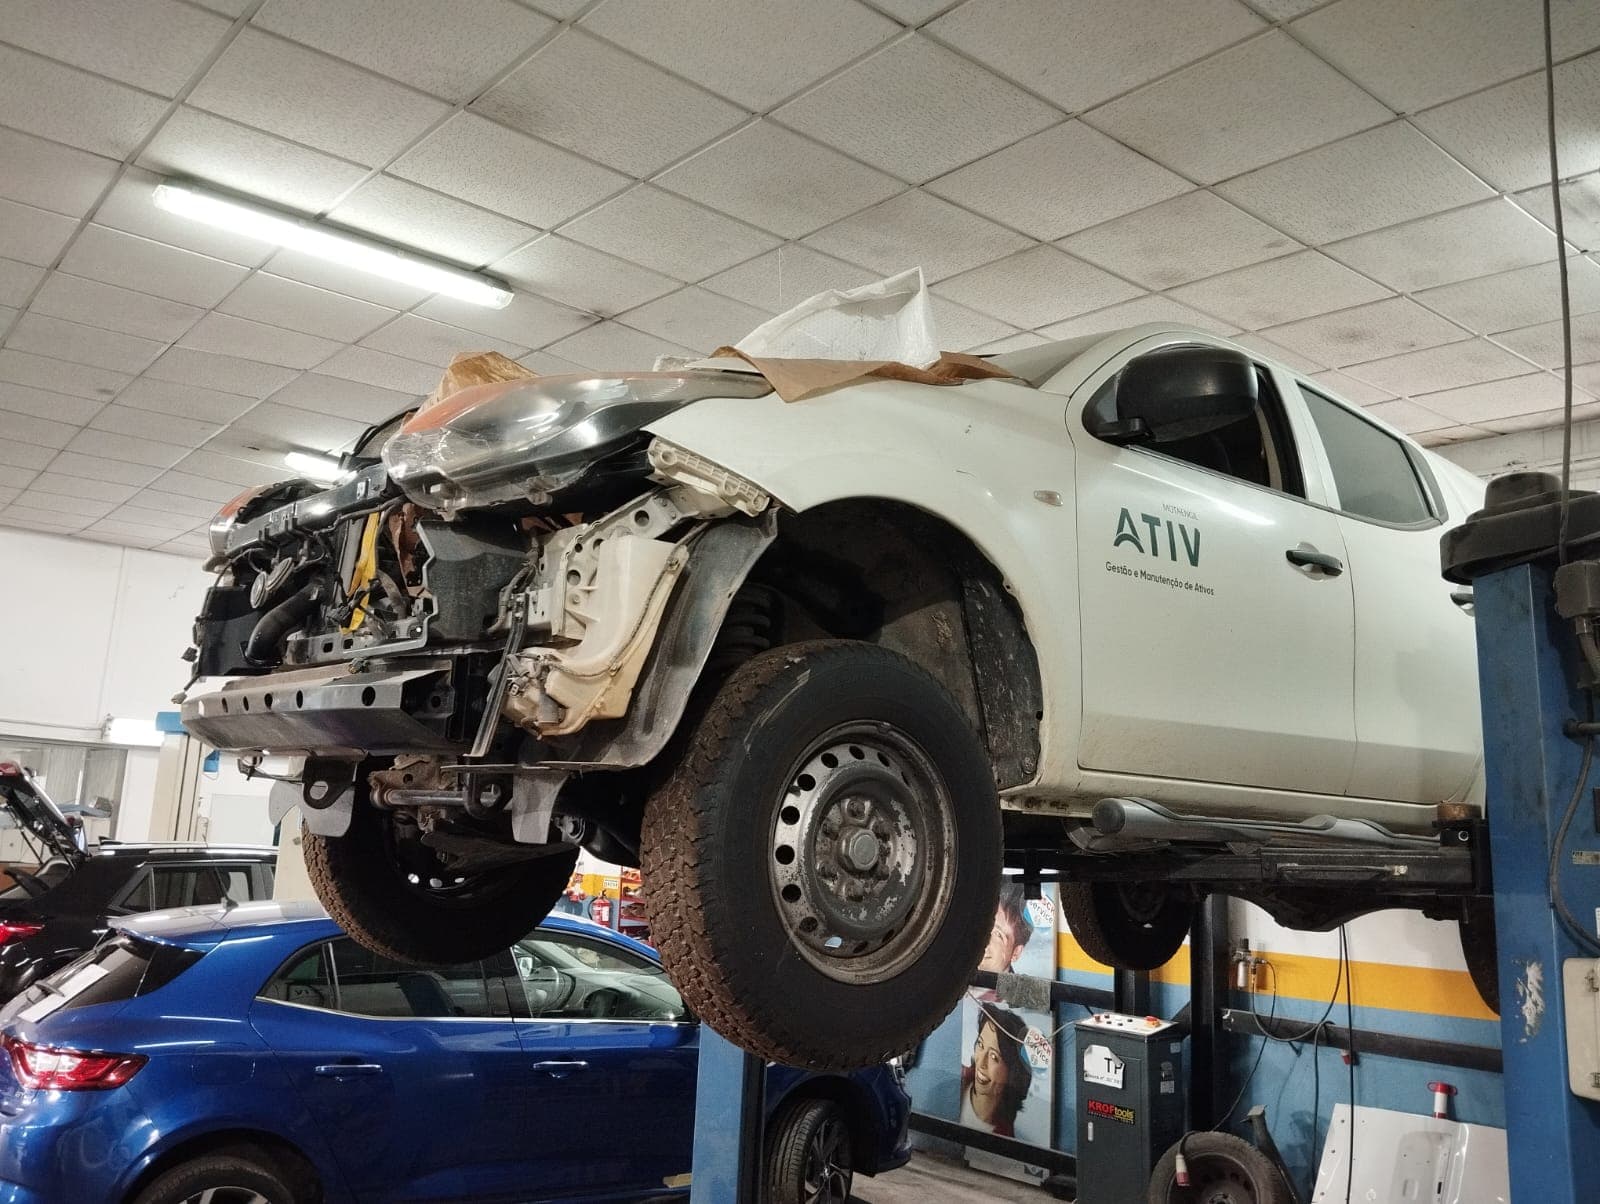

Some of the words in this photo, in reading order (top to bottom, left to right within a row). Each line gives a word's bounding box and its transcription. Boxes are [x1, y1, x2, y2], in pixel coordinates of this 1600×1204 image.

[1113, 507, 1200, 567] ATIV
[1105, 561, 1132, 576] Gestão
[1133, 570, 1139, 578] e
[1140, 569, 1183, 589] Manutenção
[1184, 581, 1193, 590] de
[1194, 583, 1214, 596] Ativos
